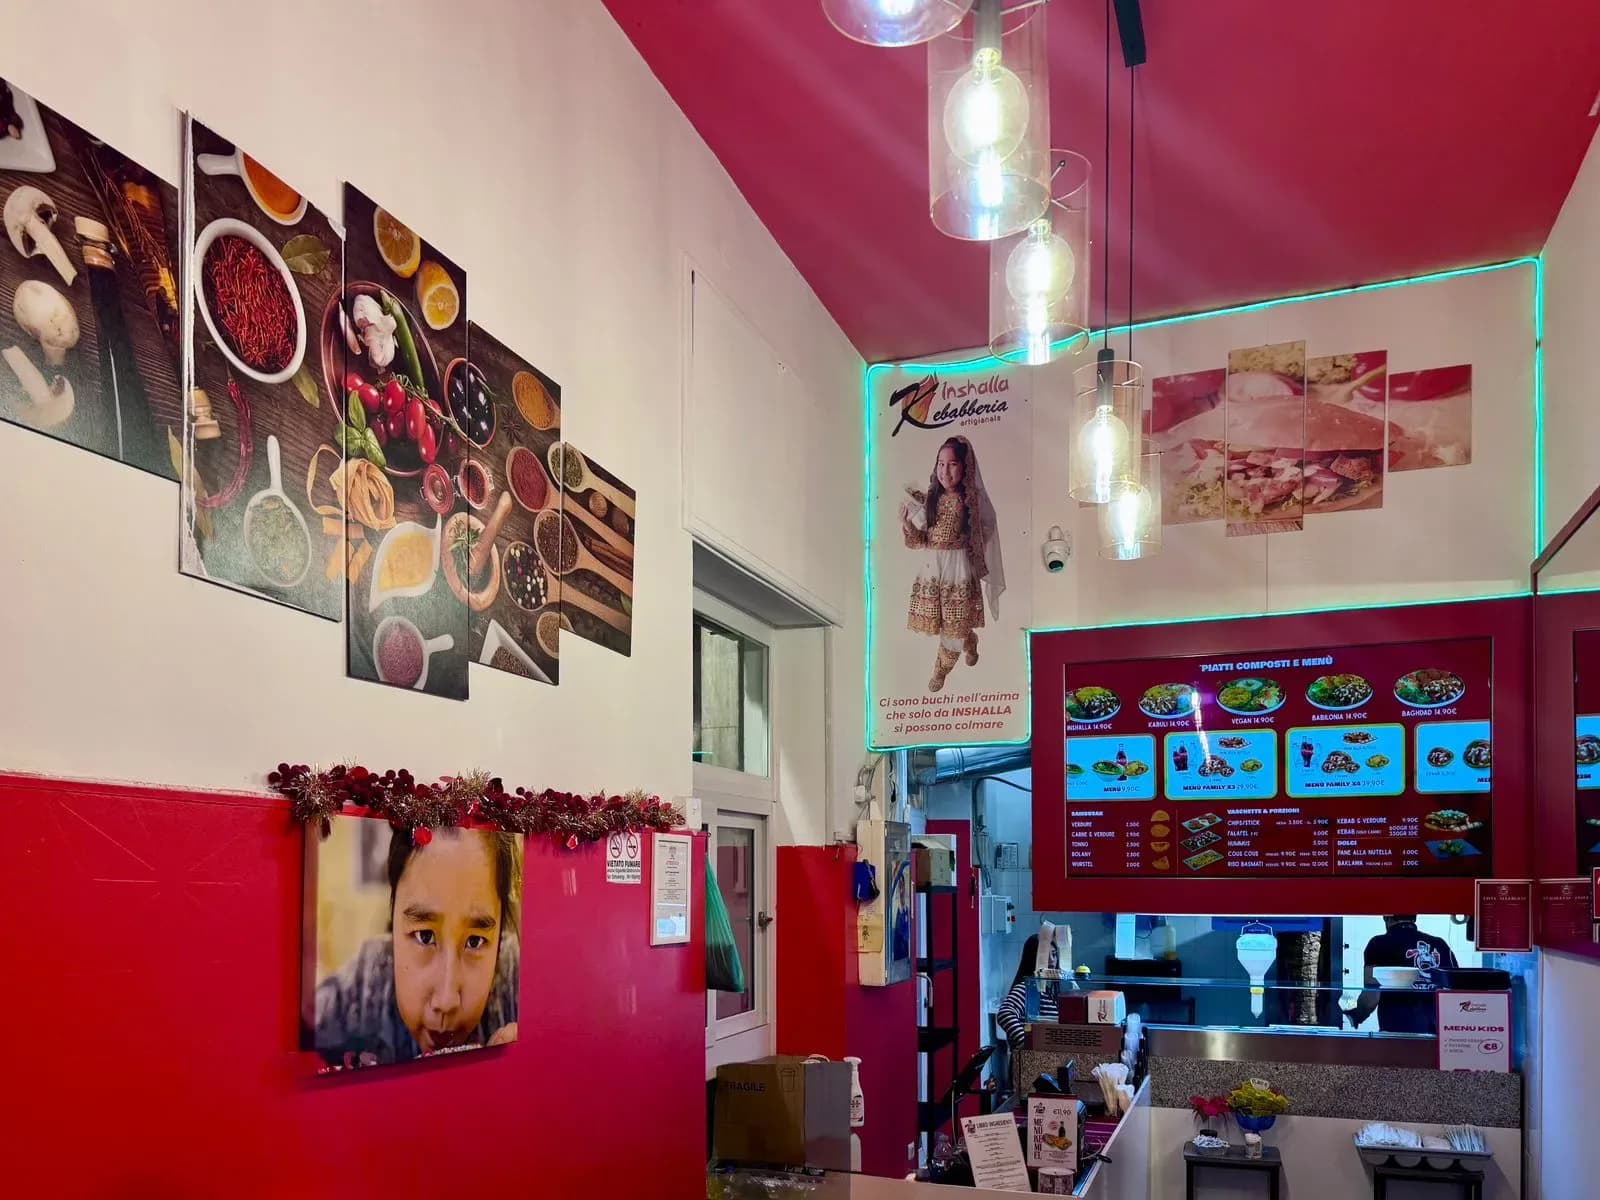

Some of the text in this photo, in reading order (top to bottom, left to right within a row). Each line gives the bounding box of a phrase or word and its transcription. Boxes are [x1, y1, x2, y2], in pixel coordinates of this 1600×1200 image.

[942, 375, 1009, 400] Inshalla
[1201, 663, 1234, 672] PIATTI
[1236, 659, 1291, 670] COMPOSTI
[1293, 658, 1299, 667] E
[879, 692, 1020, 707] Ci sono buchi nell'anima
[886, 705, 1012, 720] che solo da INSHALLA
[1312, 713, 1344, 721] BABILONIA
[894, 720, 1004, 734] si possono colmare
[1231, 717, 1252, 725] VEGAN
[607, 860, 641, 868] VIETATO FUMARE
